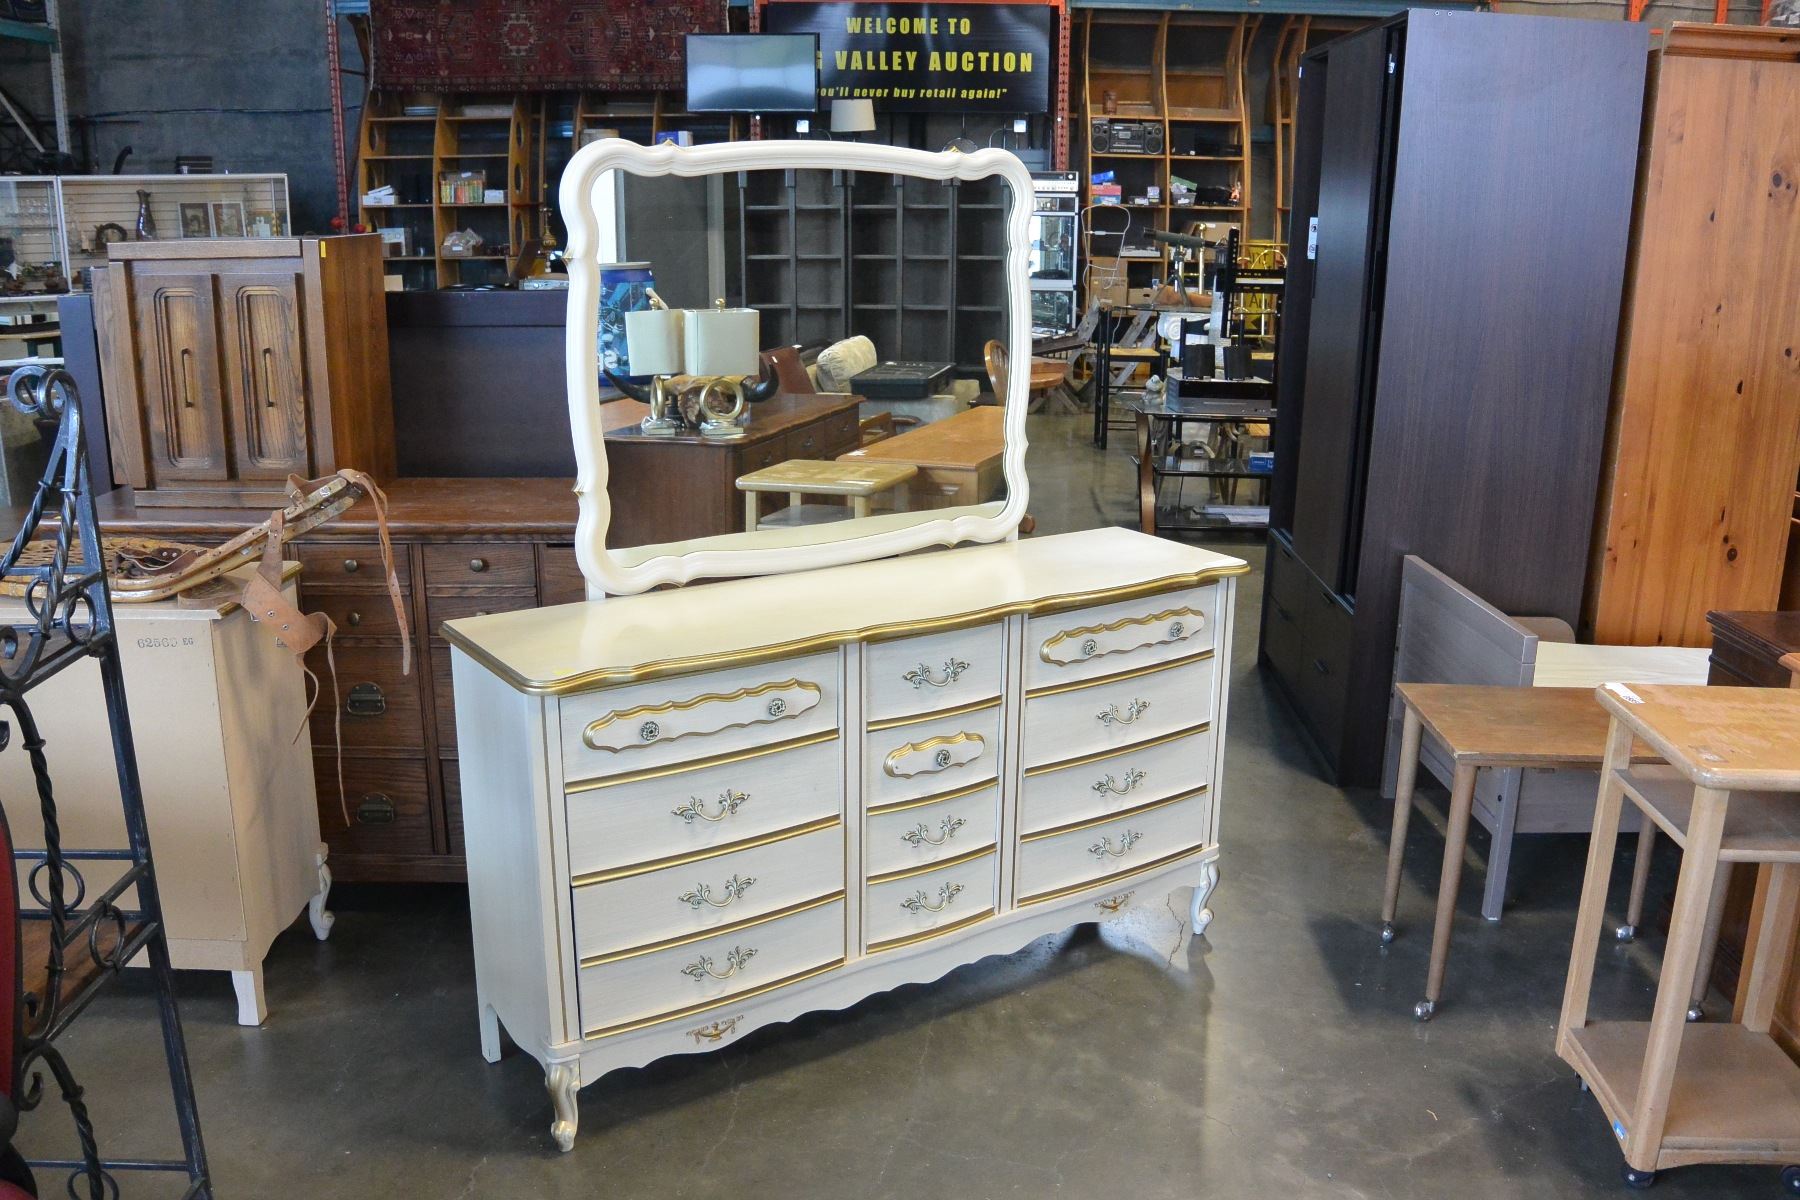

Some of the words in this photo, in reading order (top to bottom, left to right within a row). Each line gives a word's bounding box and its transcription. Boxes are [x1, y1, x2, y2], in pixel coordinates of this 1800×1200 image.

[846, 17, 938, 34] WELCOME
[948, 18, 971, 35] TO
[835, 50, 917, 71] VALLEY
[928, 51, 1033, 72] AUCTION
[817, 86, 849, 97] ou'll
[853, 88, 889, 97] never
[893, 87, 916, 98] buy
[920, 88, 957, 98] retail
